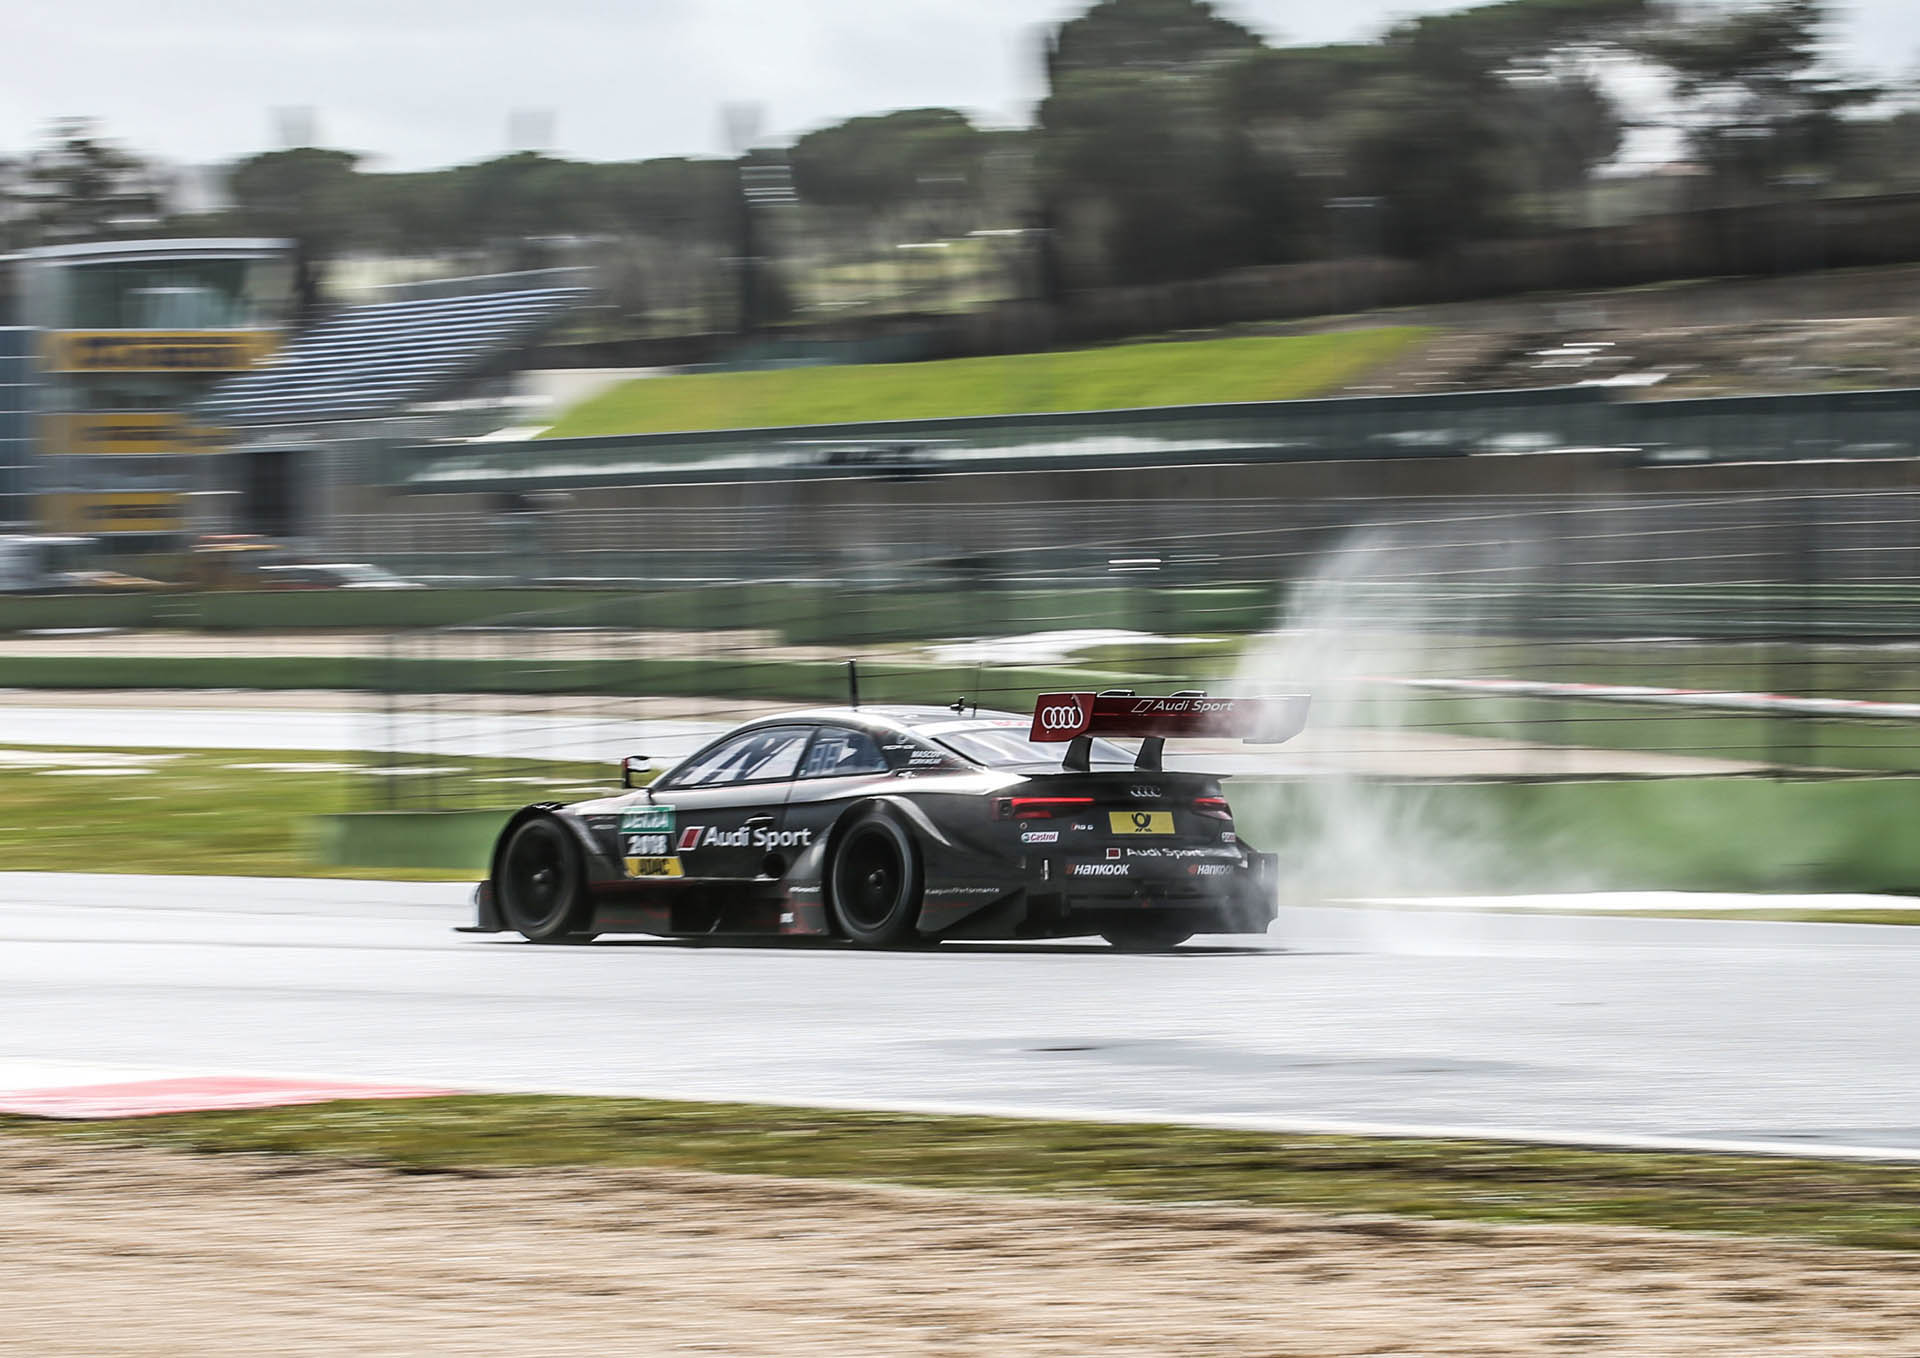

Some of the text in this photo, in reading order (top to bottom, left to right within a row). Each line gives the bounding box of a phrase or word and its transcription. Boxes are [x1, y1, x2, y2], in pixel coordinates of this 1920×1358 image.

[1153, 699, 1235, 713] Audi Sport
[627, 834, 668, 855] 2018
[702, 825, 812, 852] Audi Sport
[1030, 833, 1058, 842] Castrol
[1126, 847, 1206, 859] Audi Sport
